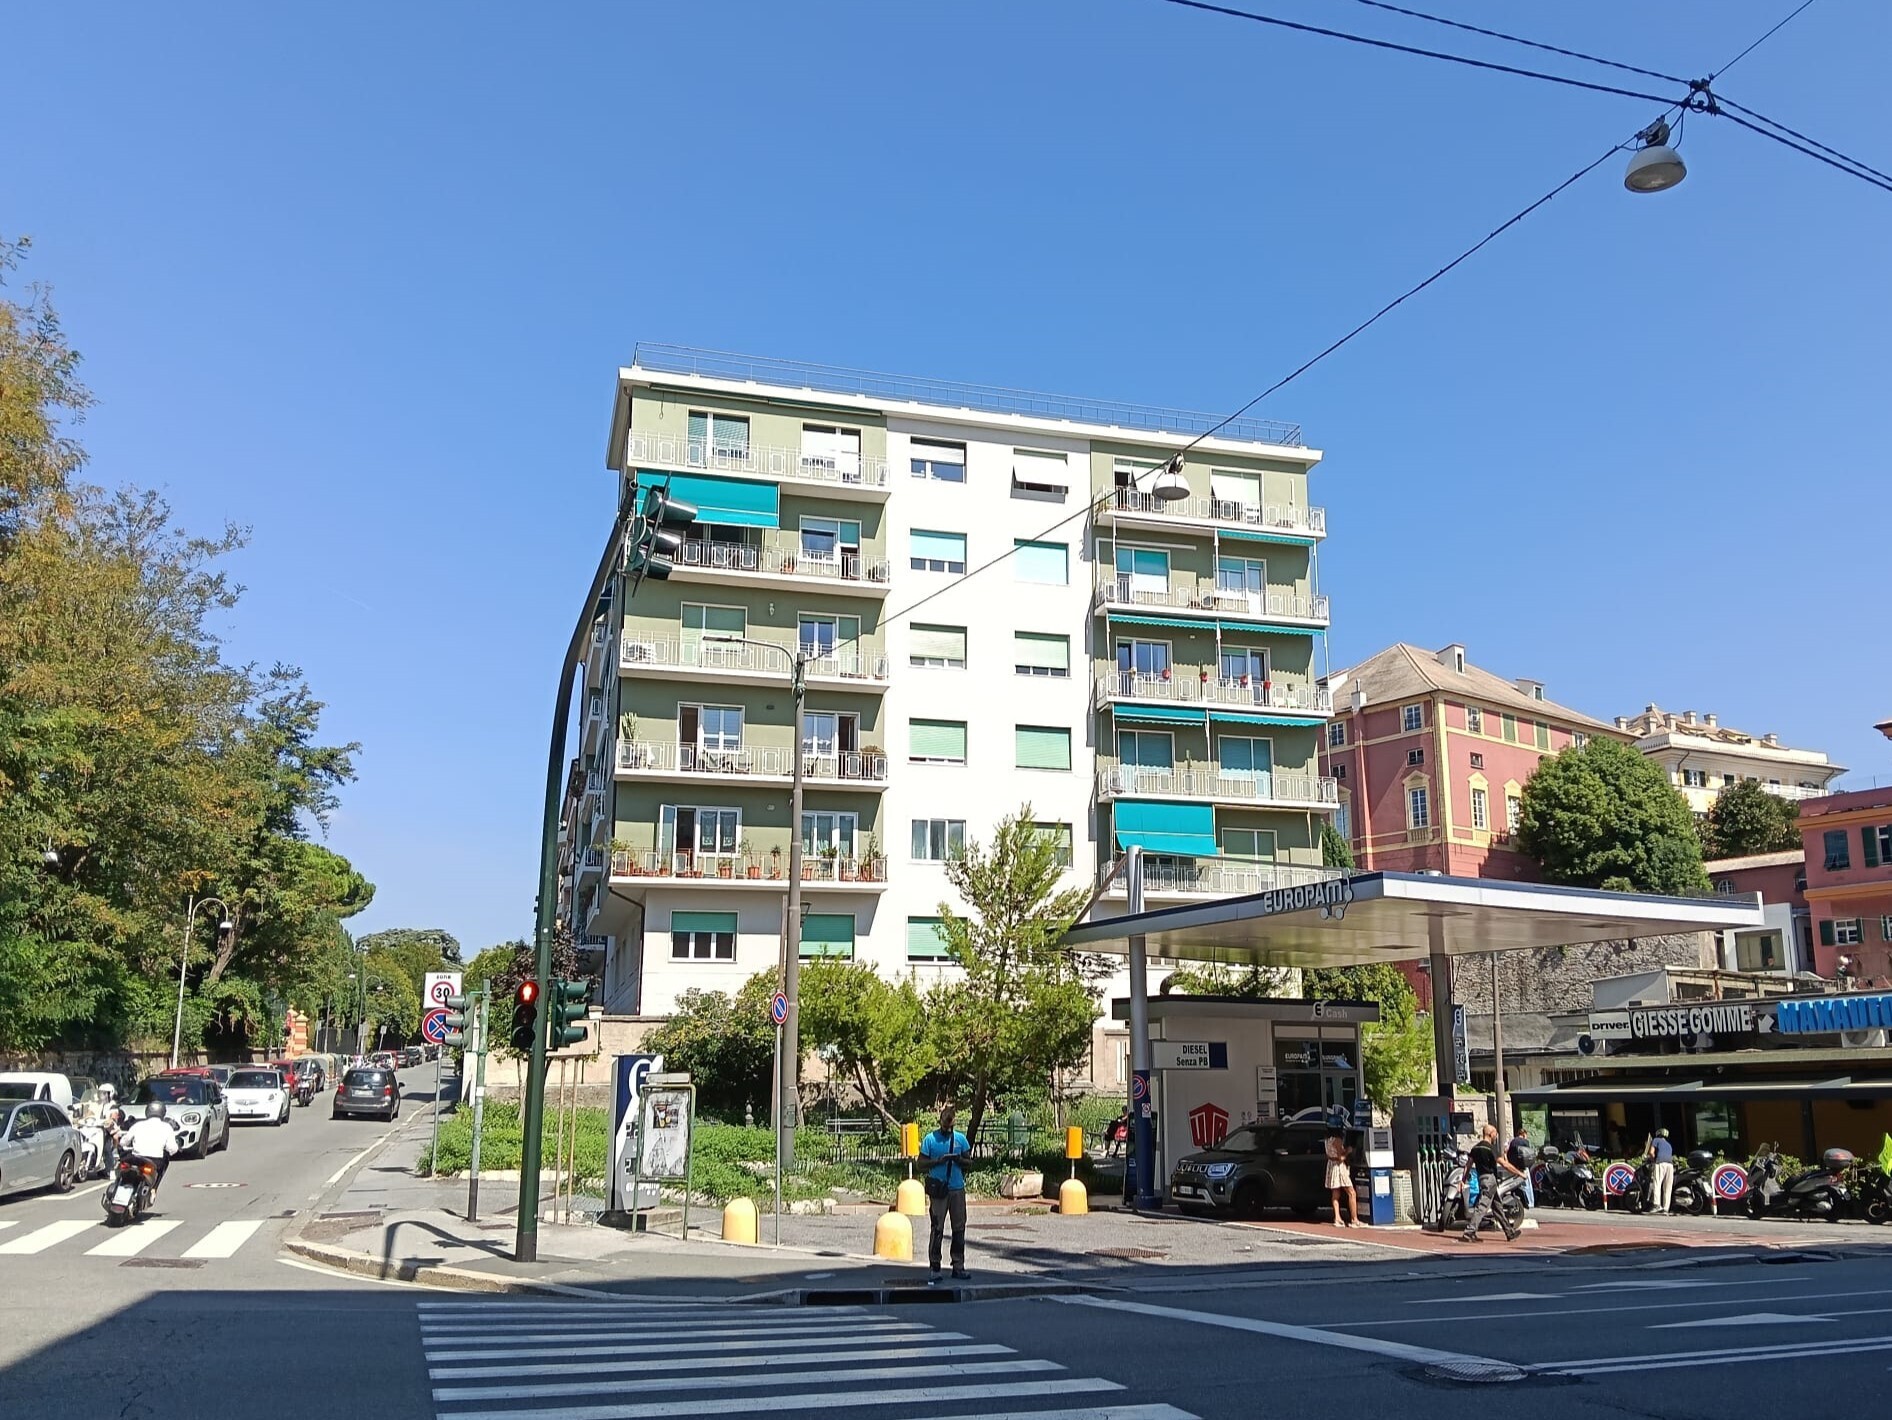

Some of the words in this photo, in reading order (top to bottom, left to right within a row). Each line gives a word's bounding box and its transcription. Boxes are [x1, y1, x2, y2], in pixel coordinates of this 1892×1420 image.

[1263, 880, 1342, 913] EUROPAM
[435, 986, 450, 999] 30
[1326, 1009, 1348, 1019] Cash
[1632, 1009, 1689, 1038] GIESSE
[1689, 1004, 1753, 1034] GOMME
[1182, 1044, 1208, 1055] DIESEL
[1176, 1056, 1198, 1067] Senza
[1198, 1056, 1209, 1066] PB
